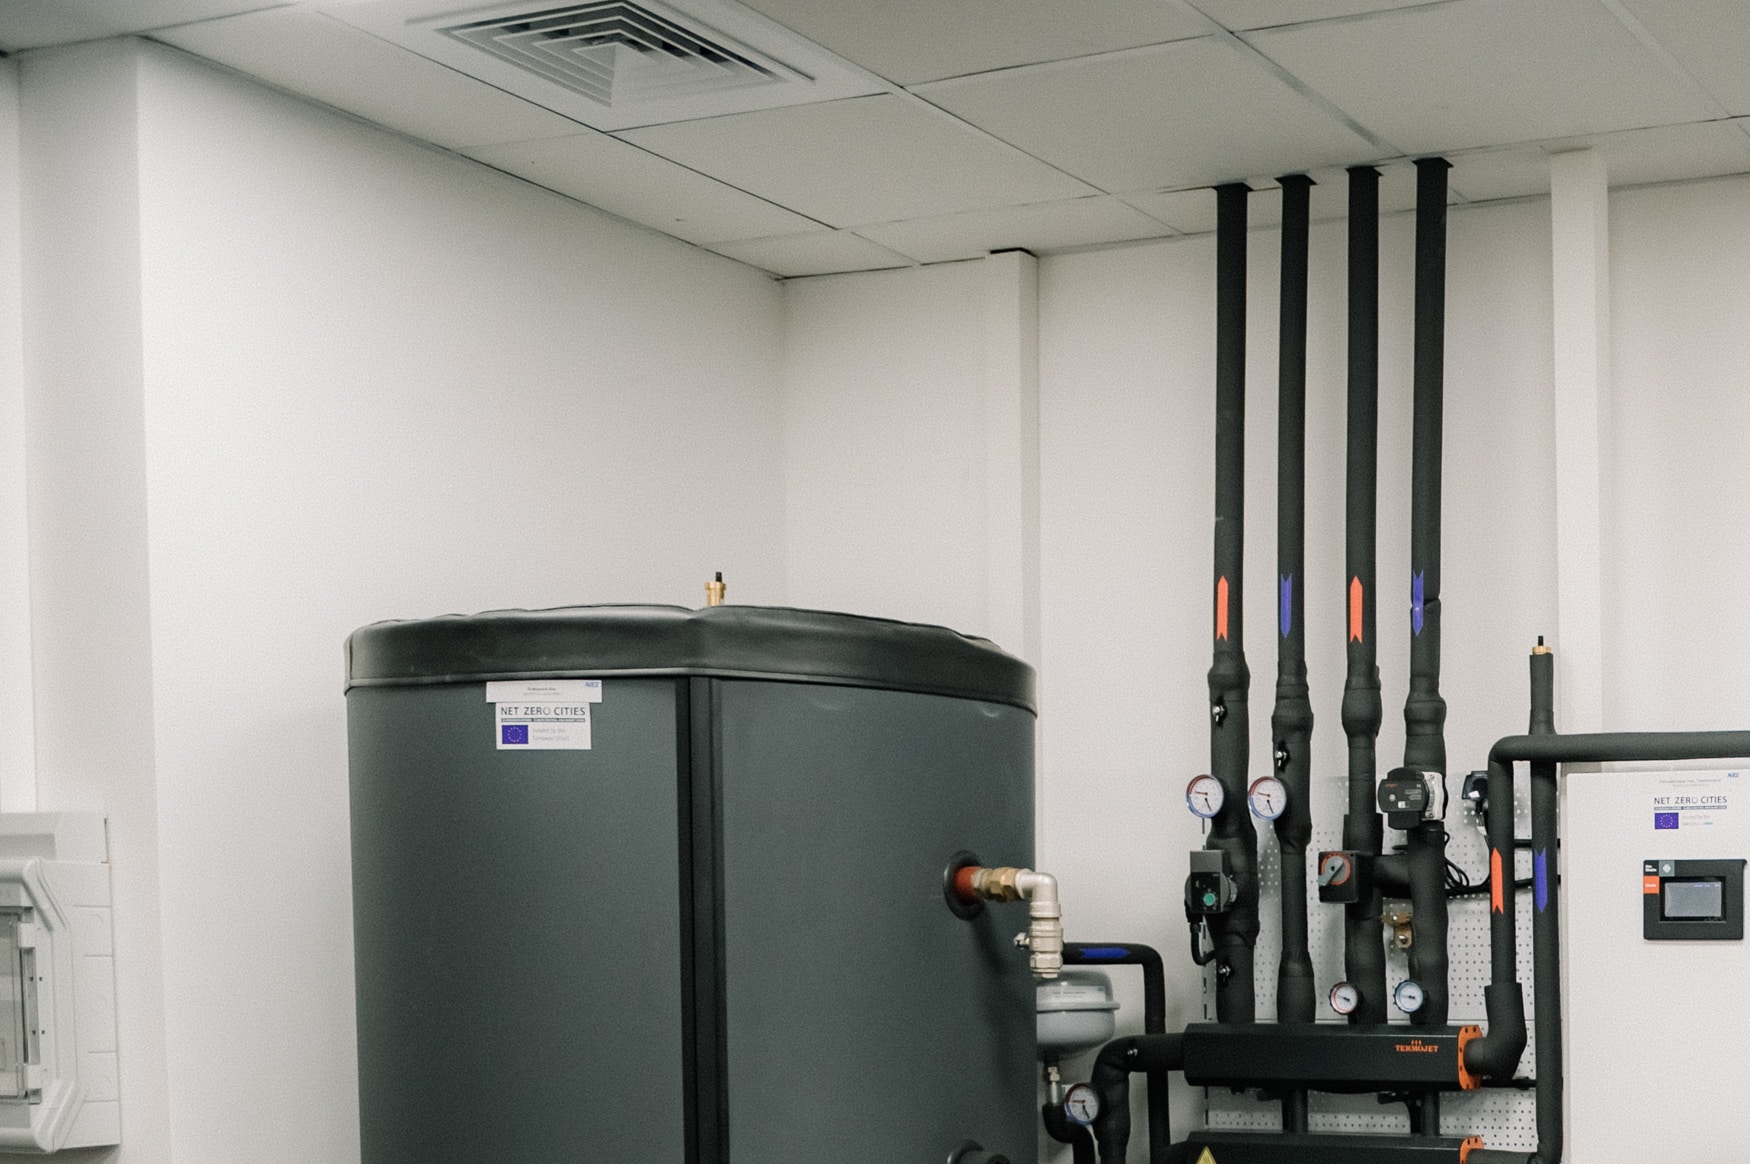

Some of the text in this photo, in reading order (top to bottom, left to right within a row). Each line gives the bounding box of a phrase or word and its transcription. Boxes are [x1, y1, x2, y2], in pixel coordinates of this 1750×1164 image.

[501, 706, 586, 716] NET ZERO CITIES
[1653, 795, 1728, 805] NET ZERO CITIES
